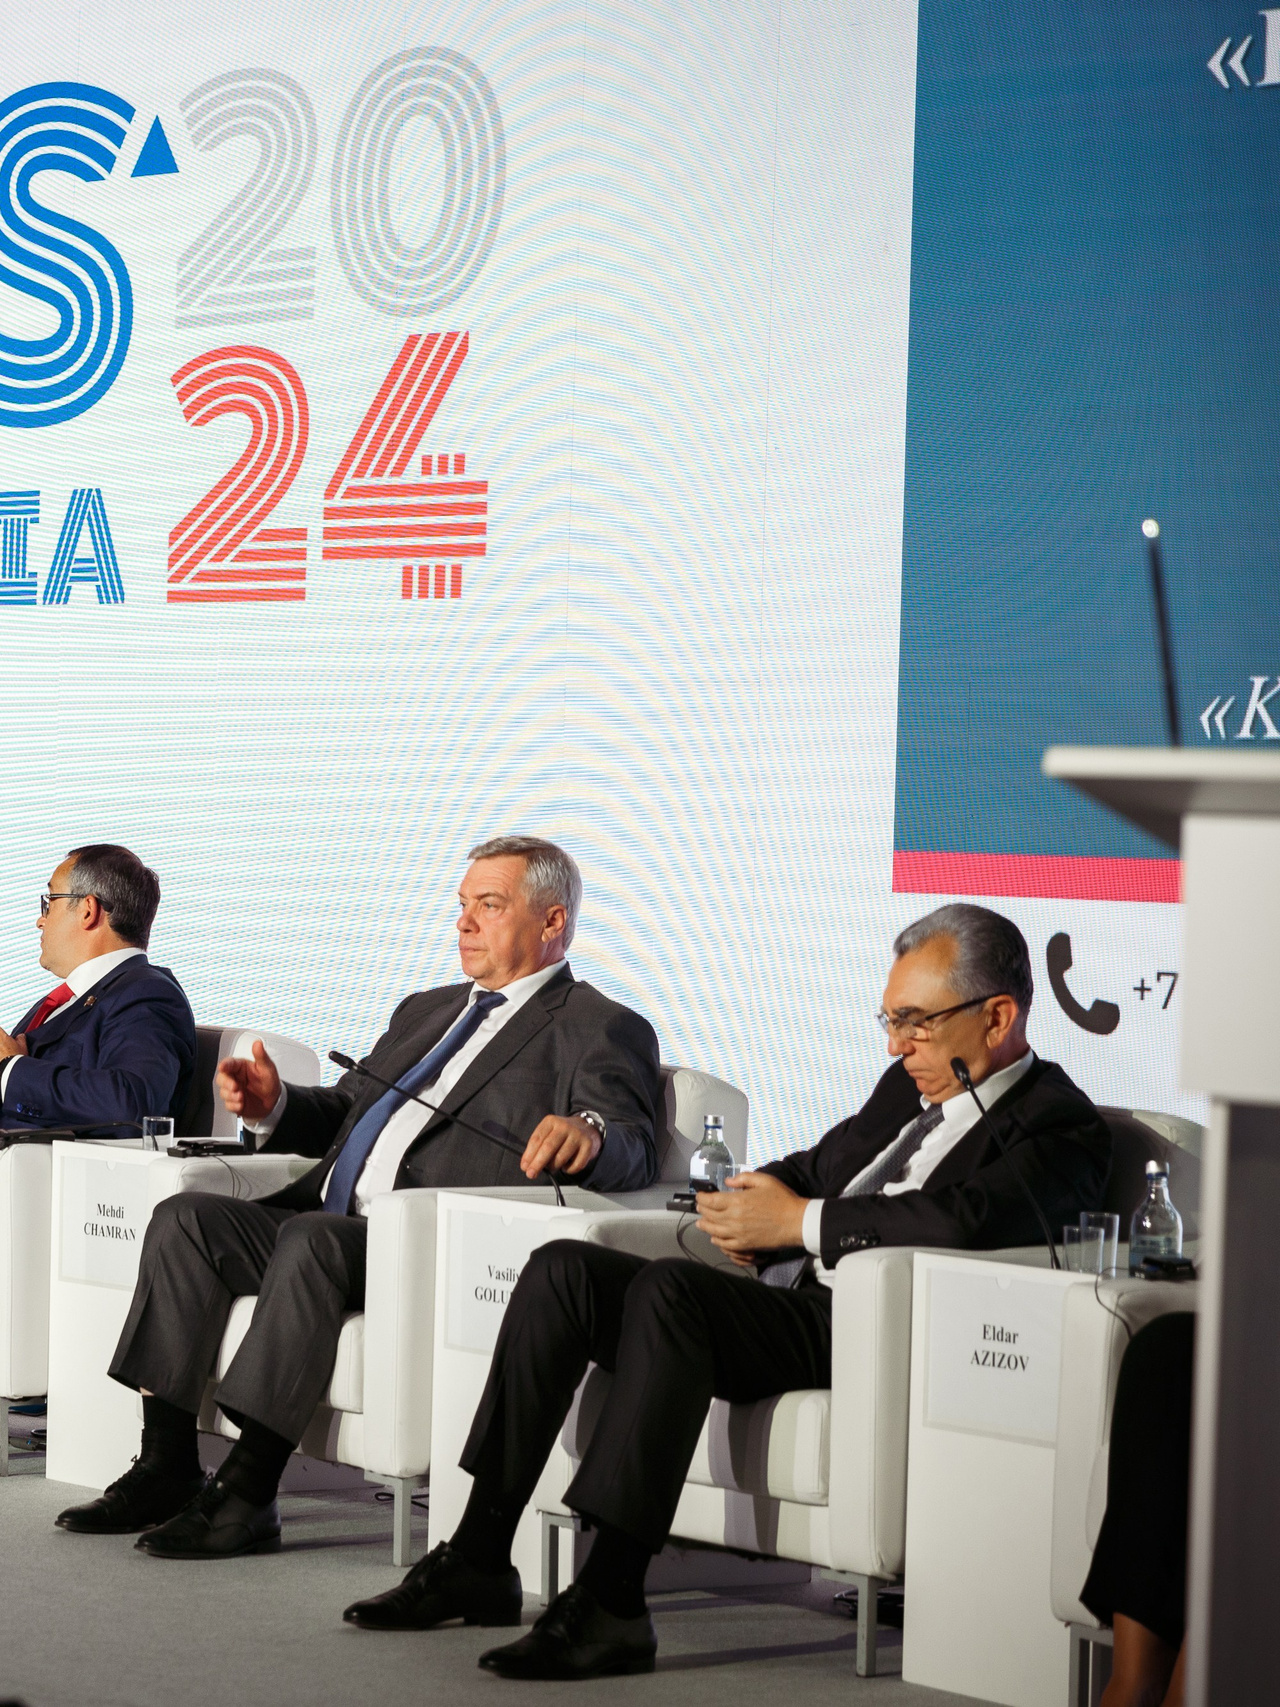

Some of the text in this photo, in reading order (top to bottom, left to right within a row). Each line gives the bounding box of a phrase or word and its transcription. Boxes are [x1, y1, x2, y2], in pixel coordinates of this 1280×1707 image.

[174, 45, 507, 329] 20
[166, 330, 489, 604] 24
[1133, 971, 1179, 1010] +7
[96, 1203, 125, 1219] Mehdi
[83, 1222, 137, 1242] CHAMRAN
[474, 1285, 512, 1305] GOLU
[982, 1323, 1019, 1345] Eldar
[970, 1348, 1030, 1373] AZIZOV
